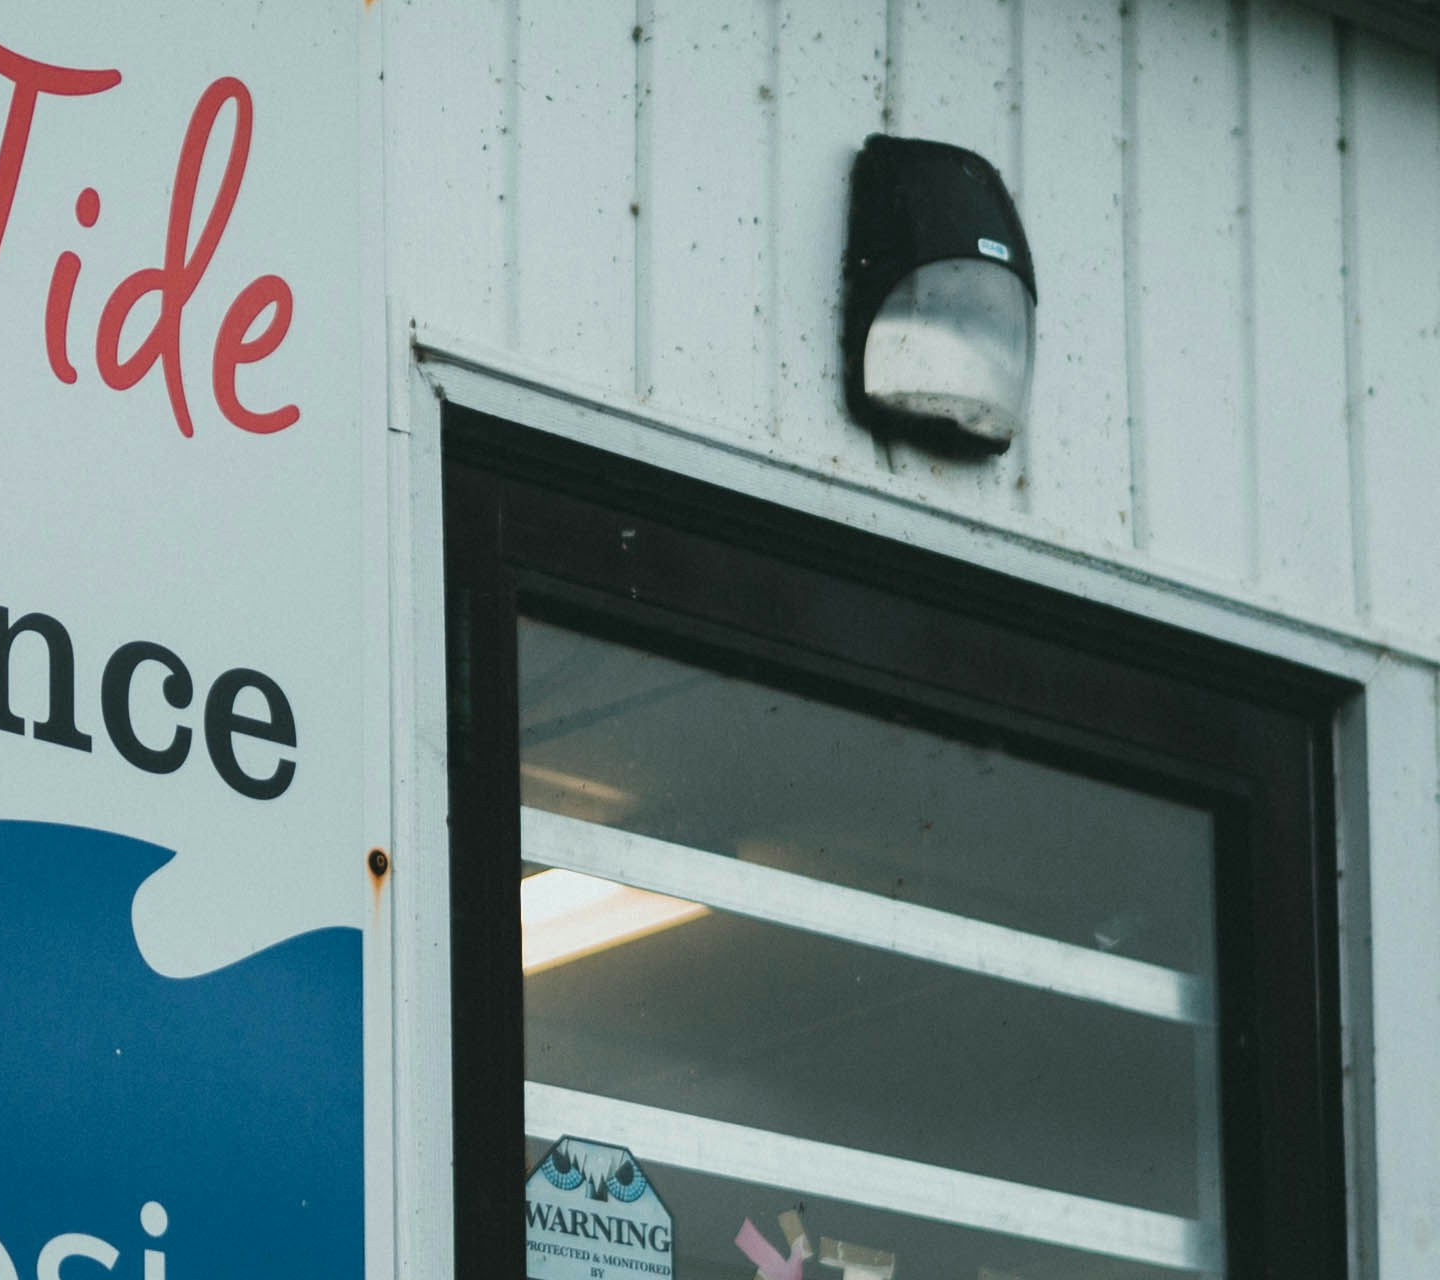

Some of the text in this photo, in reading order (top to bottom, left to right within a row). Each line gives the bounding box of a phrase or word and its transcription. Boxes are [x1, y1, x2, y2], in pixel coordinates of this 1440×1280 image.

[526, 1200, 672, 1253] WARNING
[590, 1267, 605, 1280] BY
[592, 1254, 601, 1264] &
[602, 1254, 671, 1277] MONITORED
